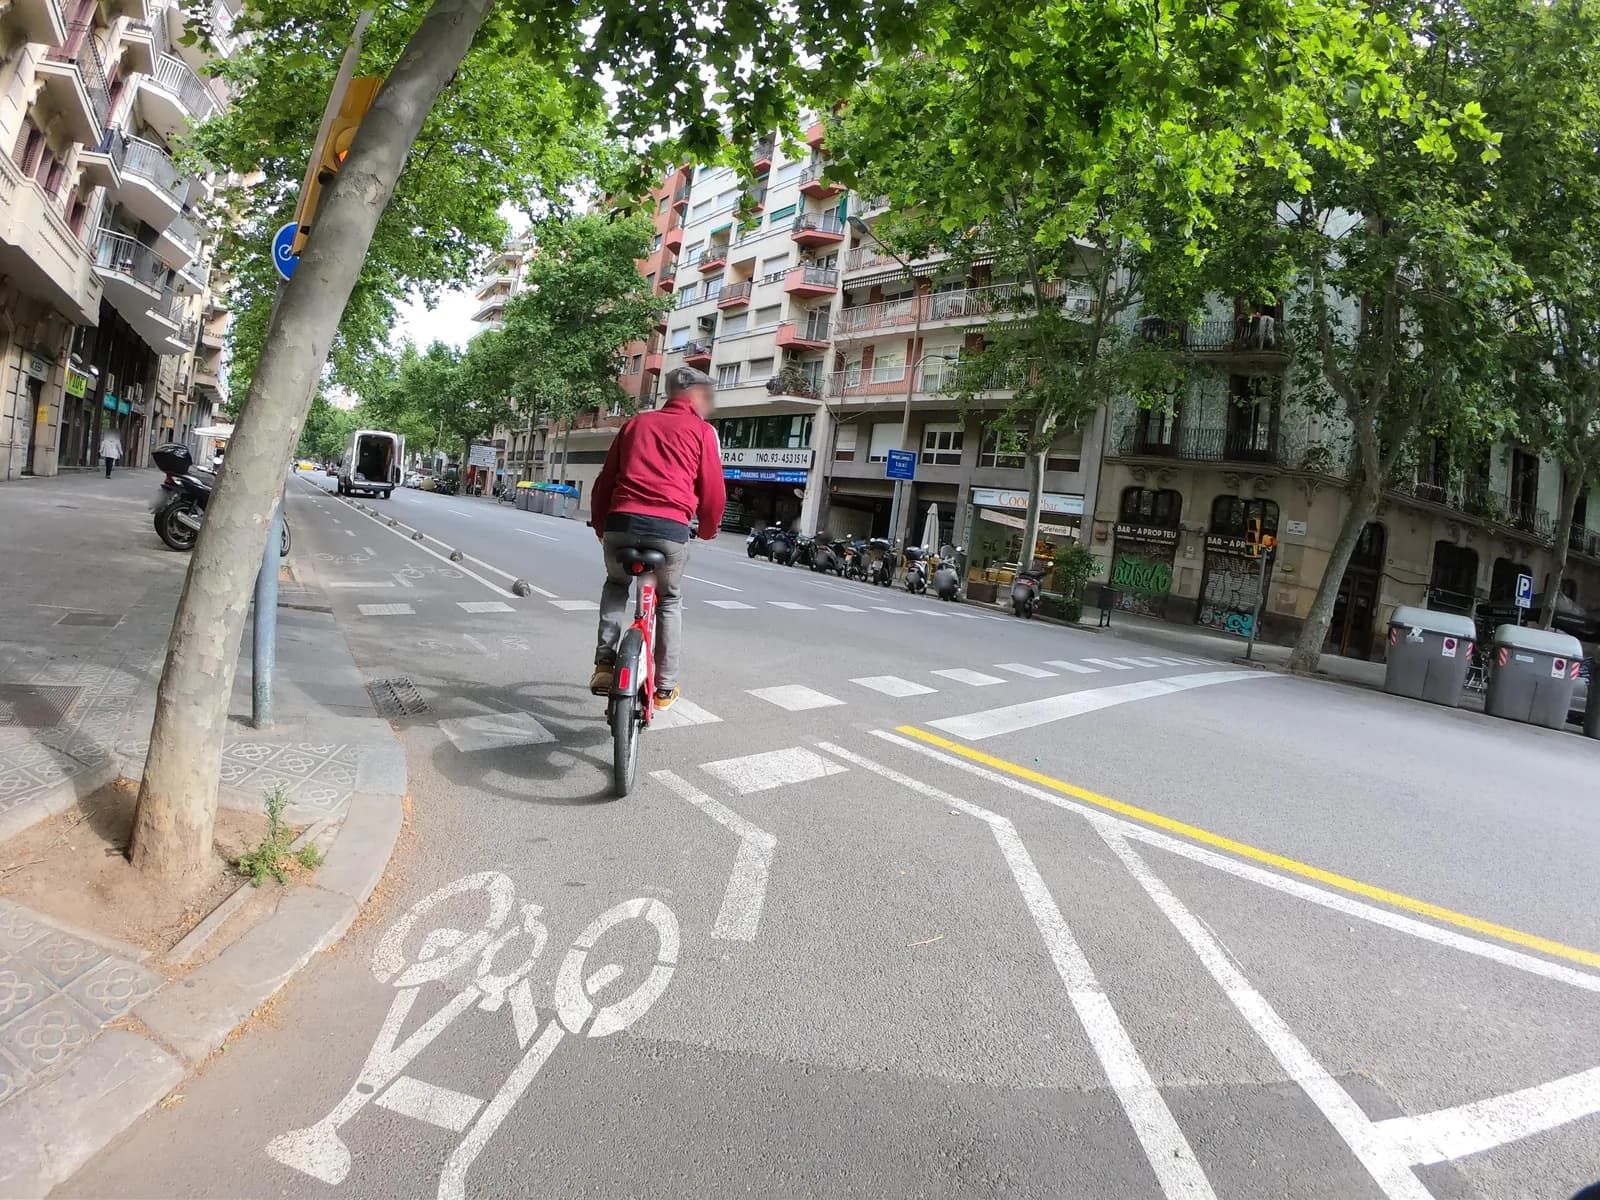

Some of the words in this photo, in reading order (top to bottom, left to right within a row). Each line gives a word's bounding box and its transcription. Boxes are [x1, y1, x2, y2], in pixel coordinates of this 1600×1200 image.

[1117, 525, 1131, 533] BAR
[1137, 527, 1142, 535] A
[1143, 528, 1162, 537] PROP
[1163, 530, 1177, 539] TEU
[1207, 536, 1222, 545] BAR
[1229, 540, 1235, 548] A
[1520, 577, 1530, 597] P
